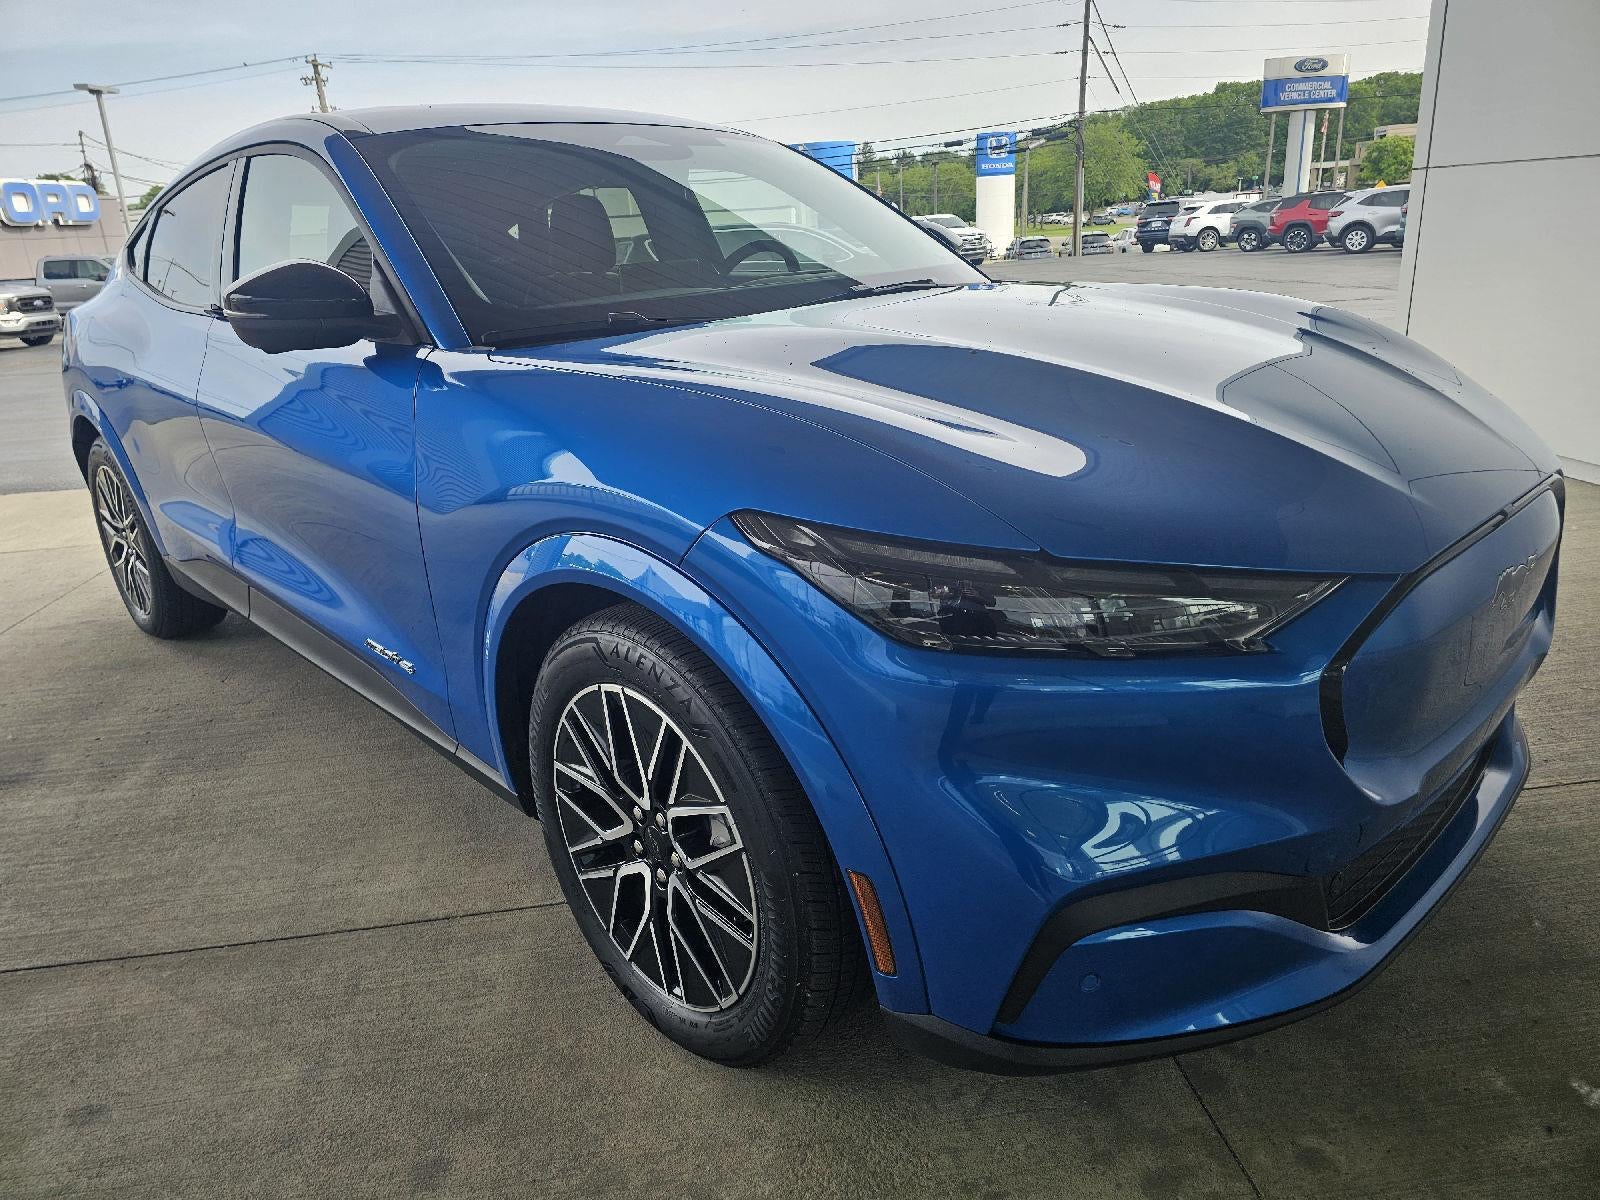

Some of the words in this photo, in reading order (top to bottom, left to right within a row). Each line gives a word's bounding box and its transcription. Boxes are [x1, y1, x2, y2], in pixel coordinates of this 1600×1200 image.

[1286, 81, 1332, 92] COMMERCIAL
[1280, 91, 1309, 100] VEHICLE
[1311, 89, 1337, 99] CENTER
[609, 642, 693, 715] ALENZA
